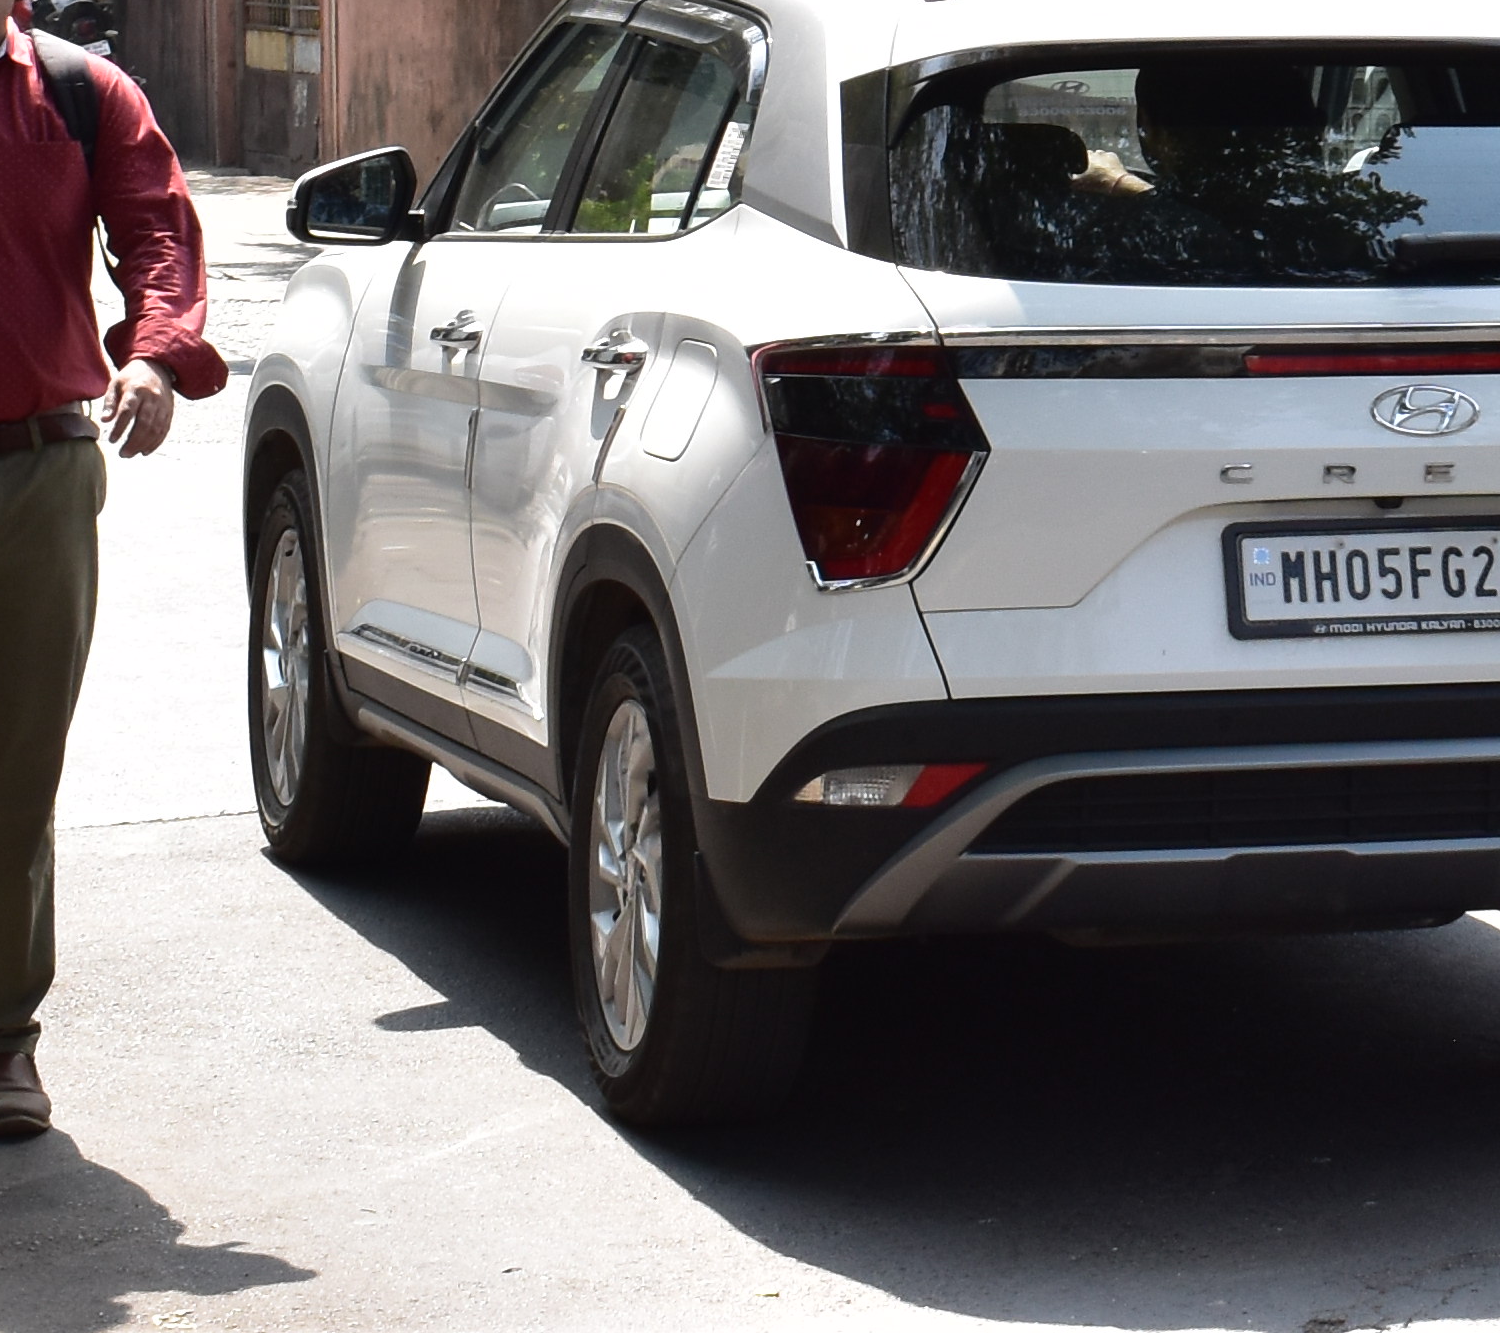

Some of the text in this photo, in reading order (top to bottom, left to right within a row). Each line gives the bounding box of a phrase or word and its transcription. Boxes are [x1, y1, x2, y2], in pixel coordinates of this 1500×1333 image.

[1249, 571, 1276, 587] IND
[1367, 621, 1418, 632] HYUNDAI
[1421, 619, 1466, 631] KALYAN
